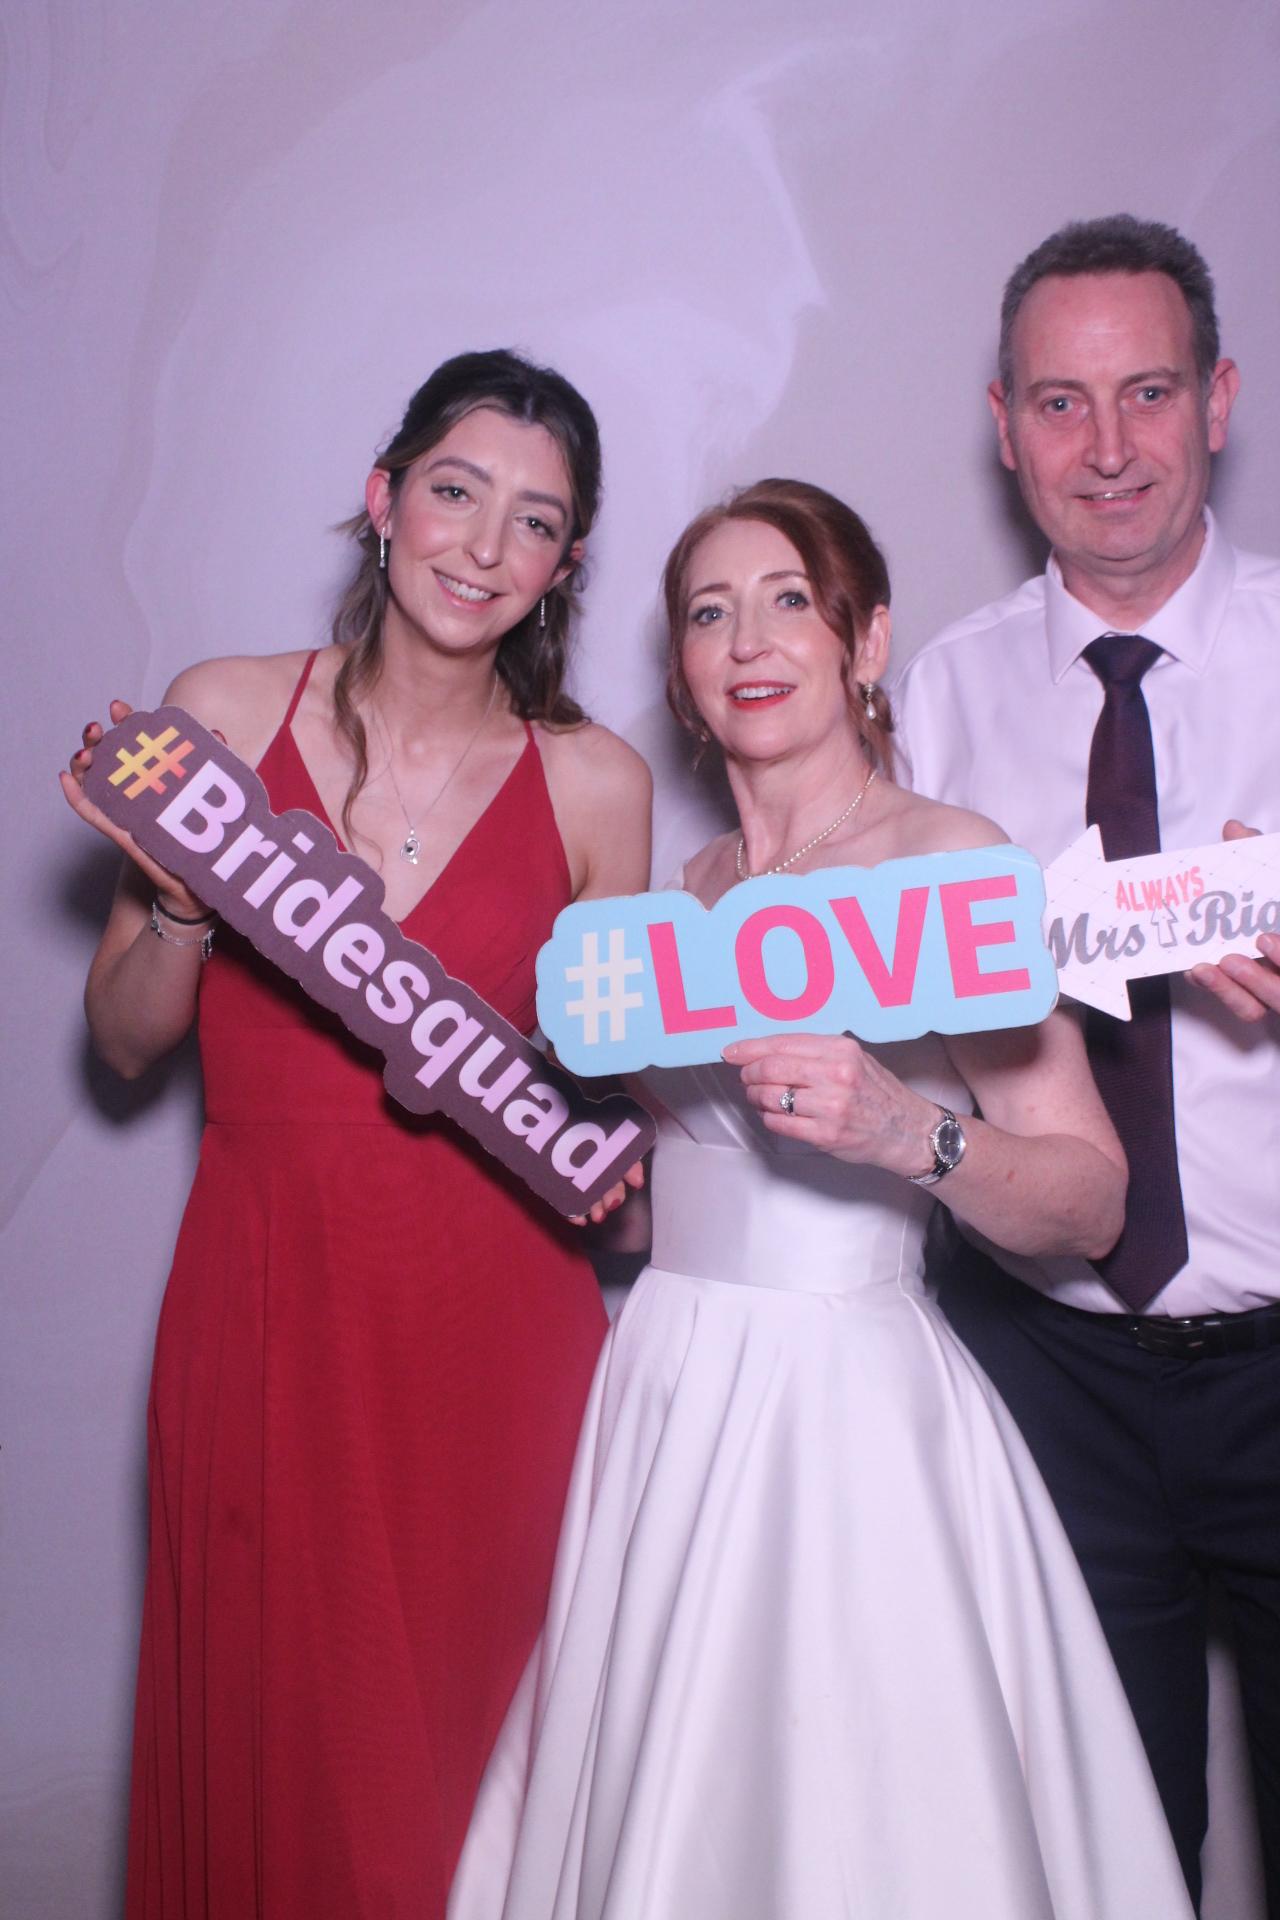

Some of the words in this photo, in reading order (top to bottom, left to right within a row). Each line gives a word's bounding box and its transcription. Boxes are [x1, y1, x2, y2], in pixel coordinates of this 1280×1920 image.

[1049, 912, 1146, 970] Mrs
[1115, 866, 1205, 913] ALWAYS
[107, 725, 641, 1192] #Bridesquad
[565, 874, 1031, 1045] #LOVE
